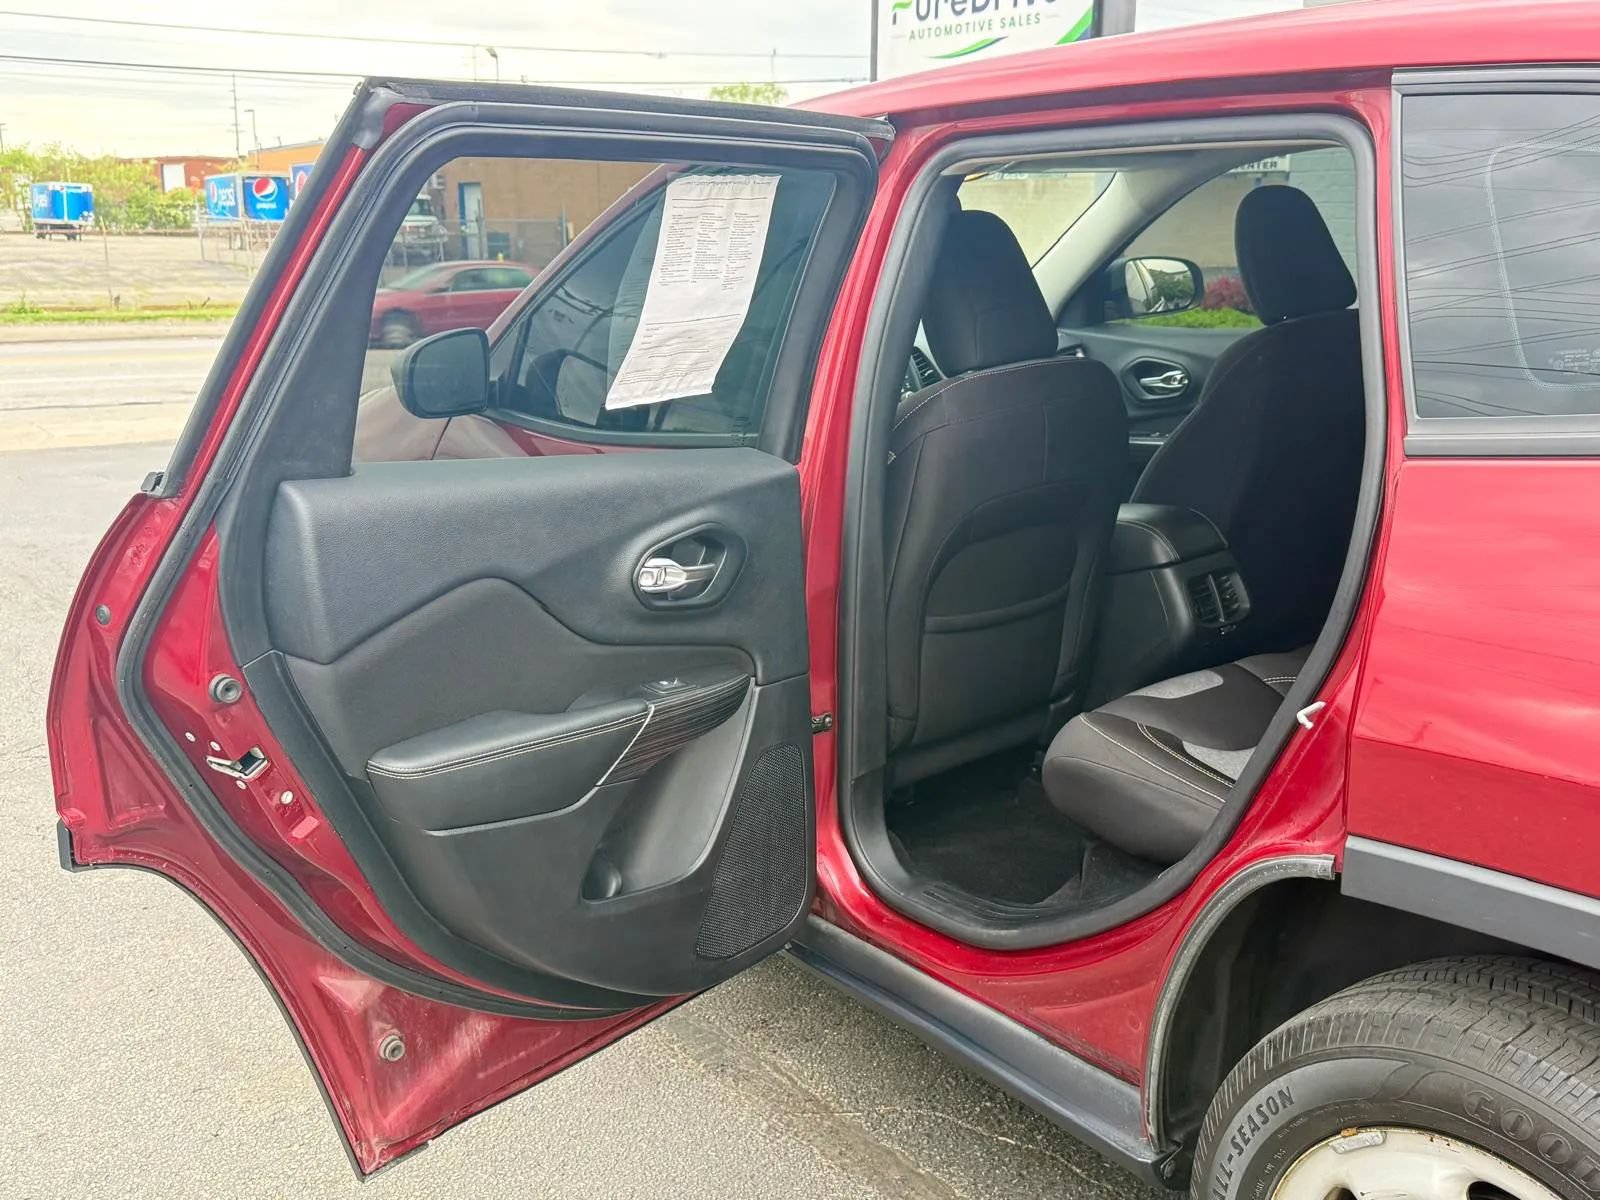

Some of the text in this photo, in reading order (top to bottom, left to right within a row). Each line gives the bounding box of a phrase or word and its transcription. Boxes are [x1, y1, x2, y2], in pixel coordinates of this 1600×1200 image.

[892, 0, 1057, 25] PureD
[909, 12, 1041, 41] AUTOMOTIVE SALES
